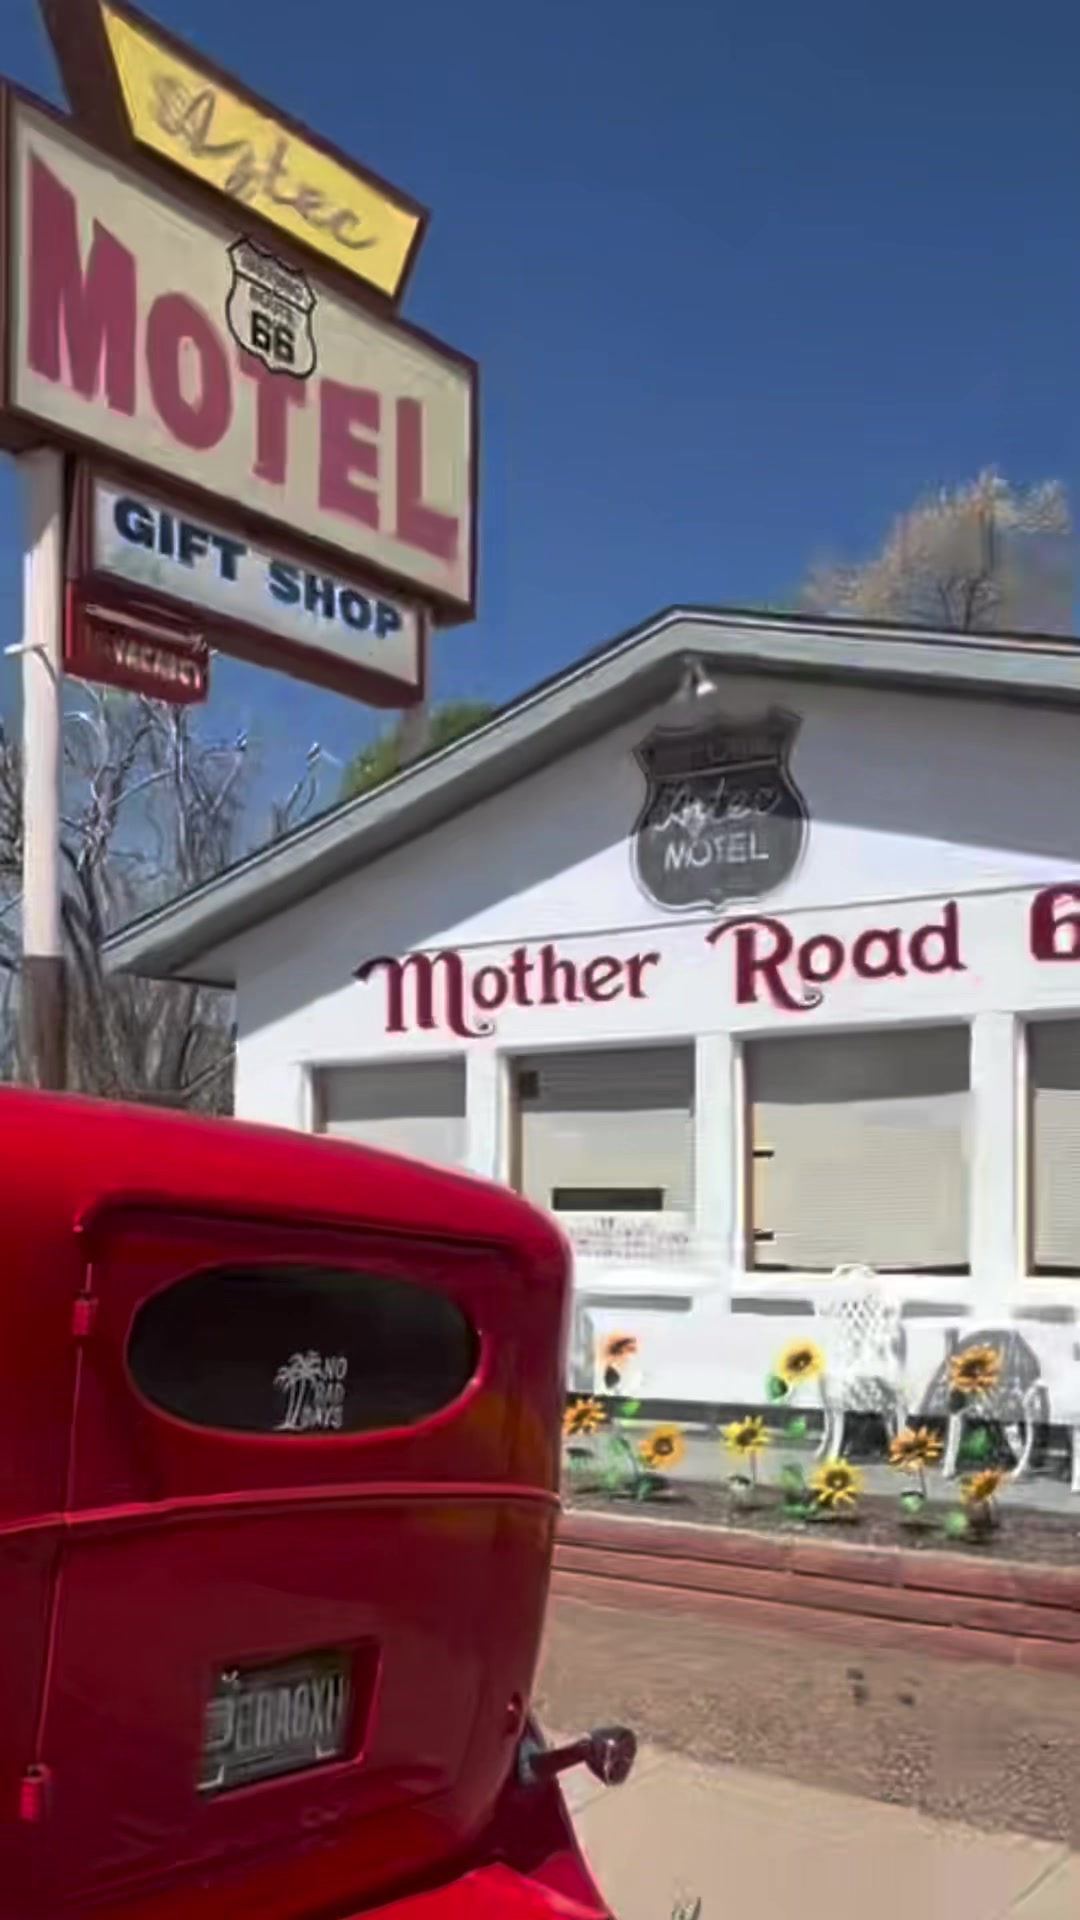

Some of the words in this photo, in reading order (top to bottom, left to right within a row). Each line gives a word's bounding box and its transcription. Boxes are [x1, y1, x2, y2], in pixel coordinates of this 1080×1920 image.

[152, 72, 380, 250] Aztec
[27, 151, 459, 561] MOTEL
[251, 309, 295, 365] 66
[113, 496, 248, 582] GIFT
[267, 556, 402, 639] SHOP
[664, 832, 769, 872] MOTEL
[351, 943, 661, 1039] Mother
[705, 900, 967, 1011] Road
[324, 1356, 348, 1380] NO
